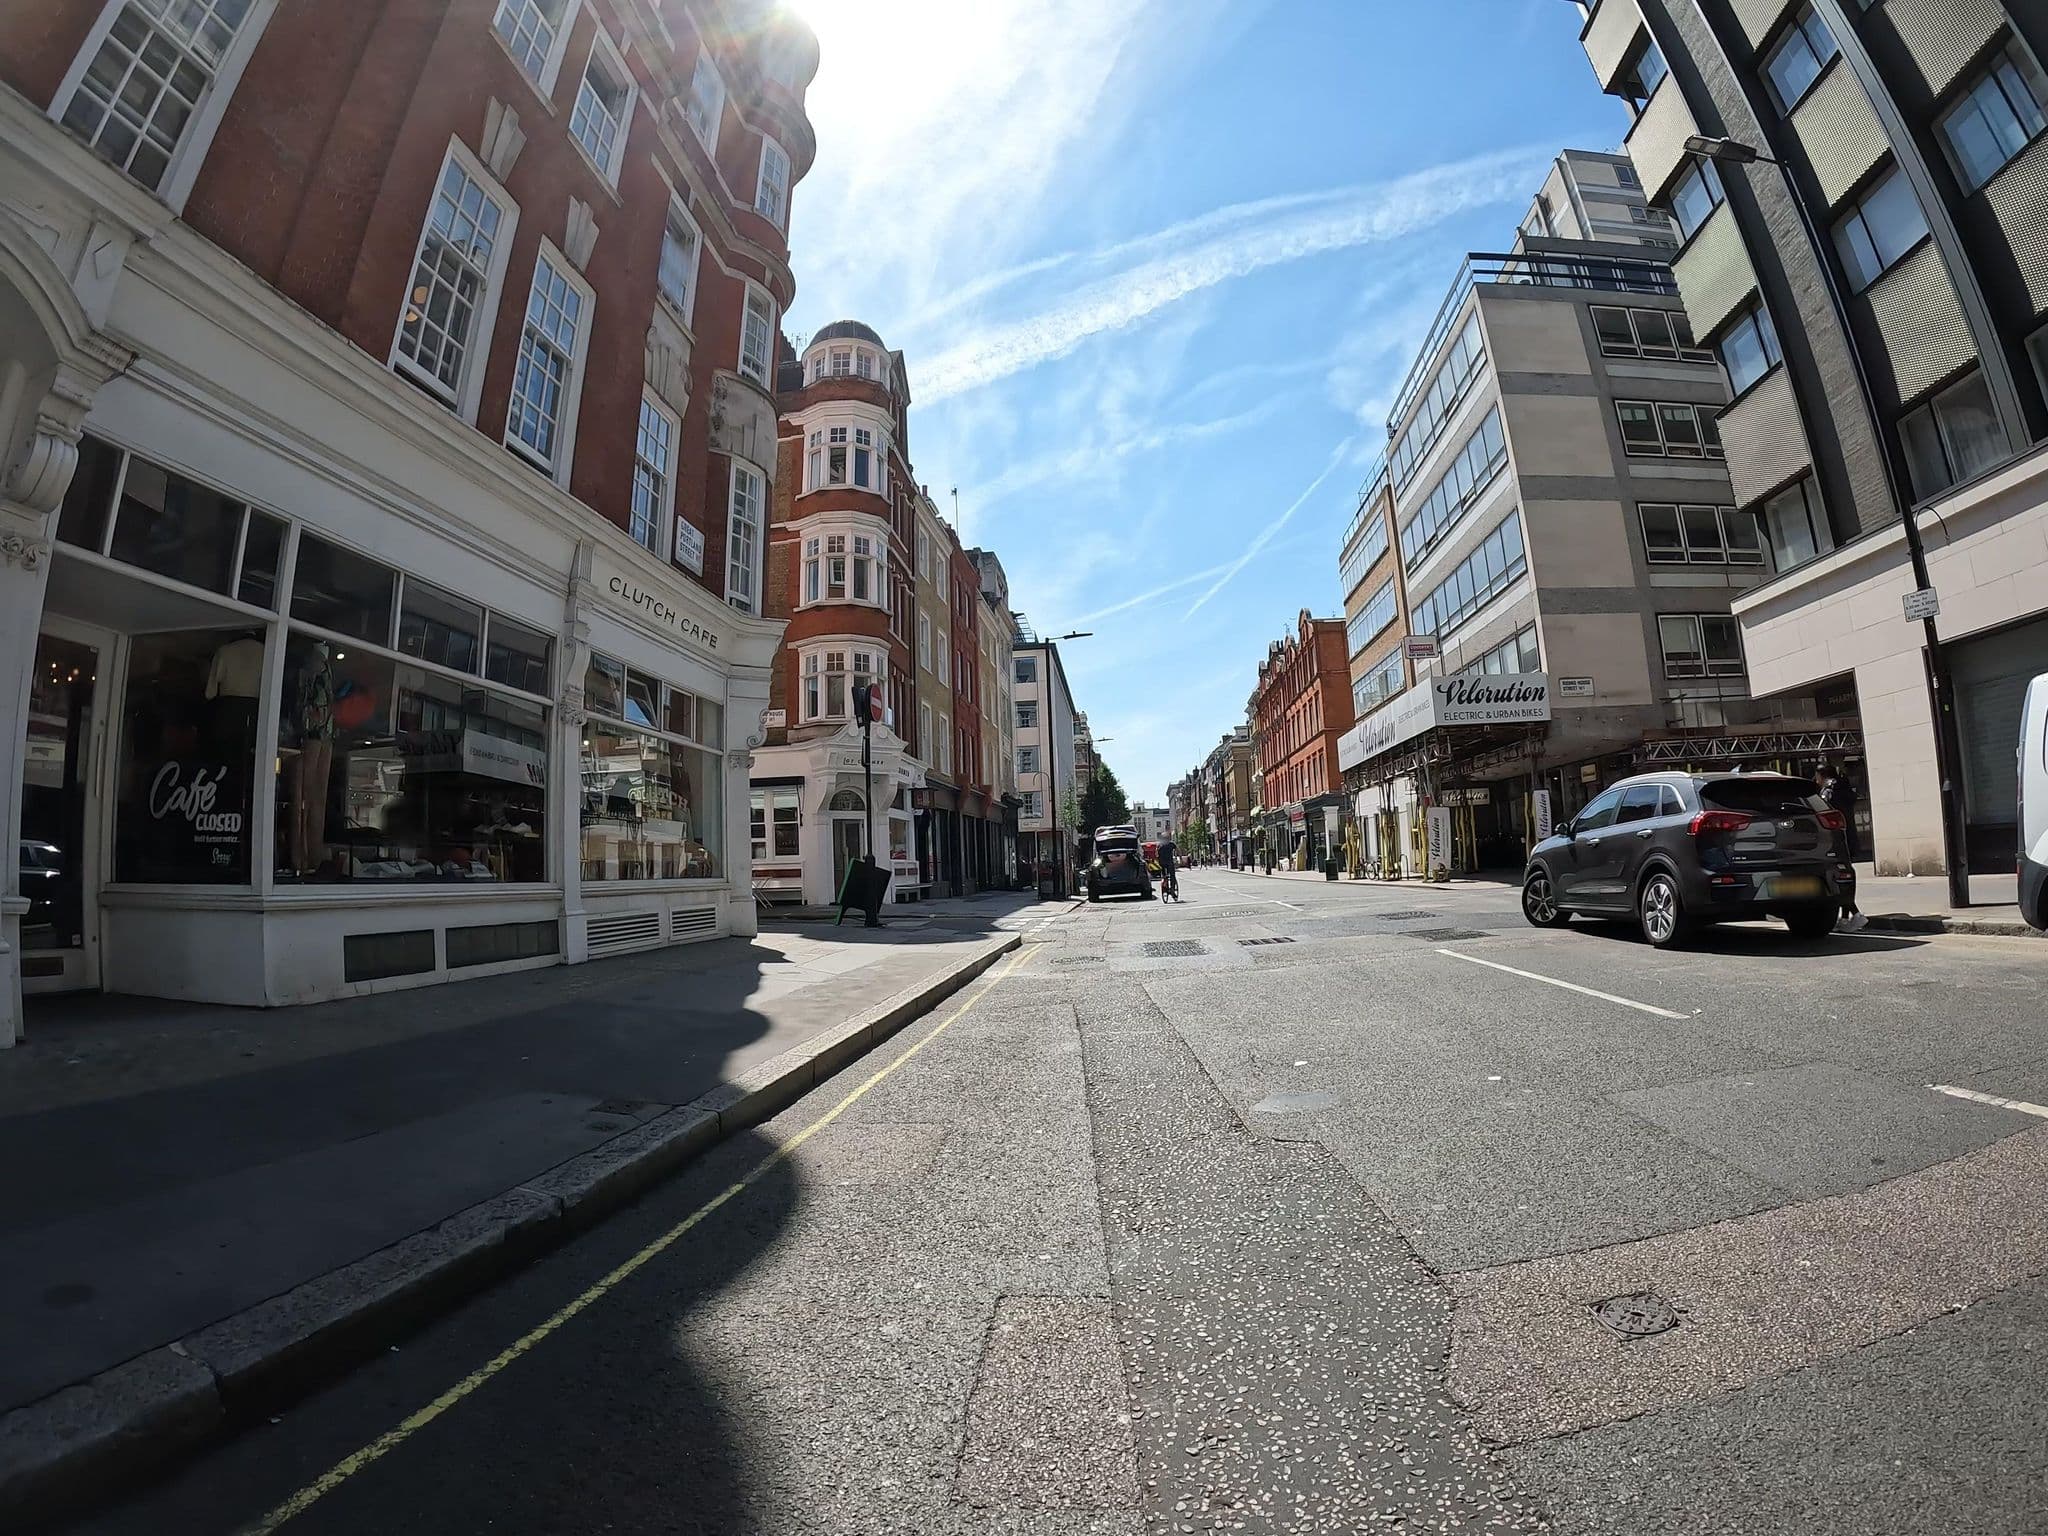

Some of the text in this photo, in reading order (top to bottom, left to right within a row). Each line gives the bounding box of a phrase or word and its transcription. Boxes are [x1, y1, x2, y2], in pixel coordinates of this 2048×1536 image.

[680, 530, 702, 554] PORTLAND
[680, 541, 695, 559] STREET
[609, 577, 718, 649] CLUTCH CAFE
[1436, 677, 1546, 707] Velorution
[1444, 708, 1544, 721] ELECTRIC & URBAN BIKES
[1359, 716, 1396, 758] Velorution
[149, 761, 228, 821] Café
[628, 786, 688, 809] CLUTCH
[195, 813, 241, 832] CLOSED
